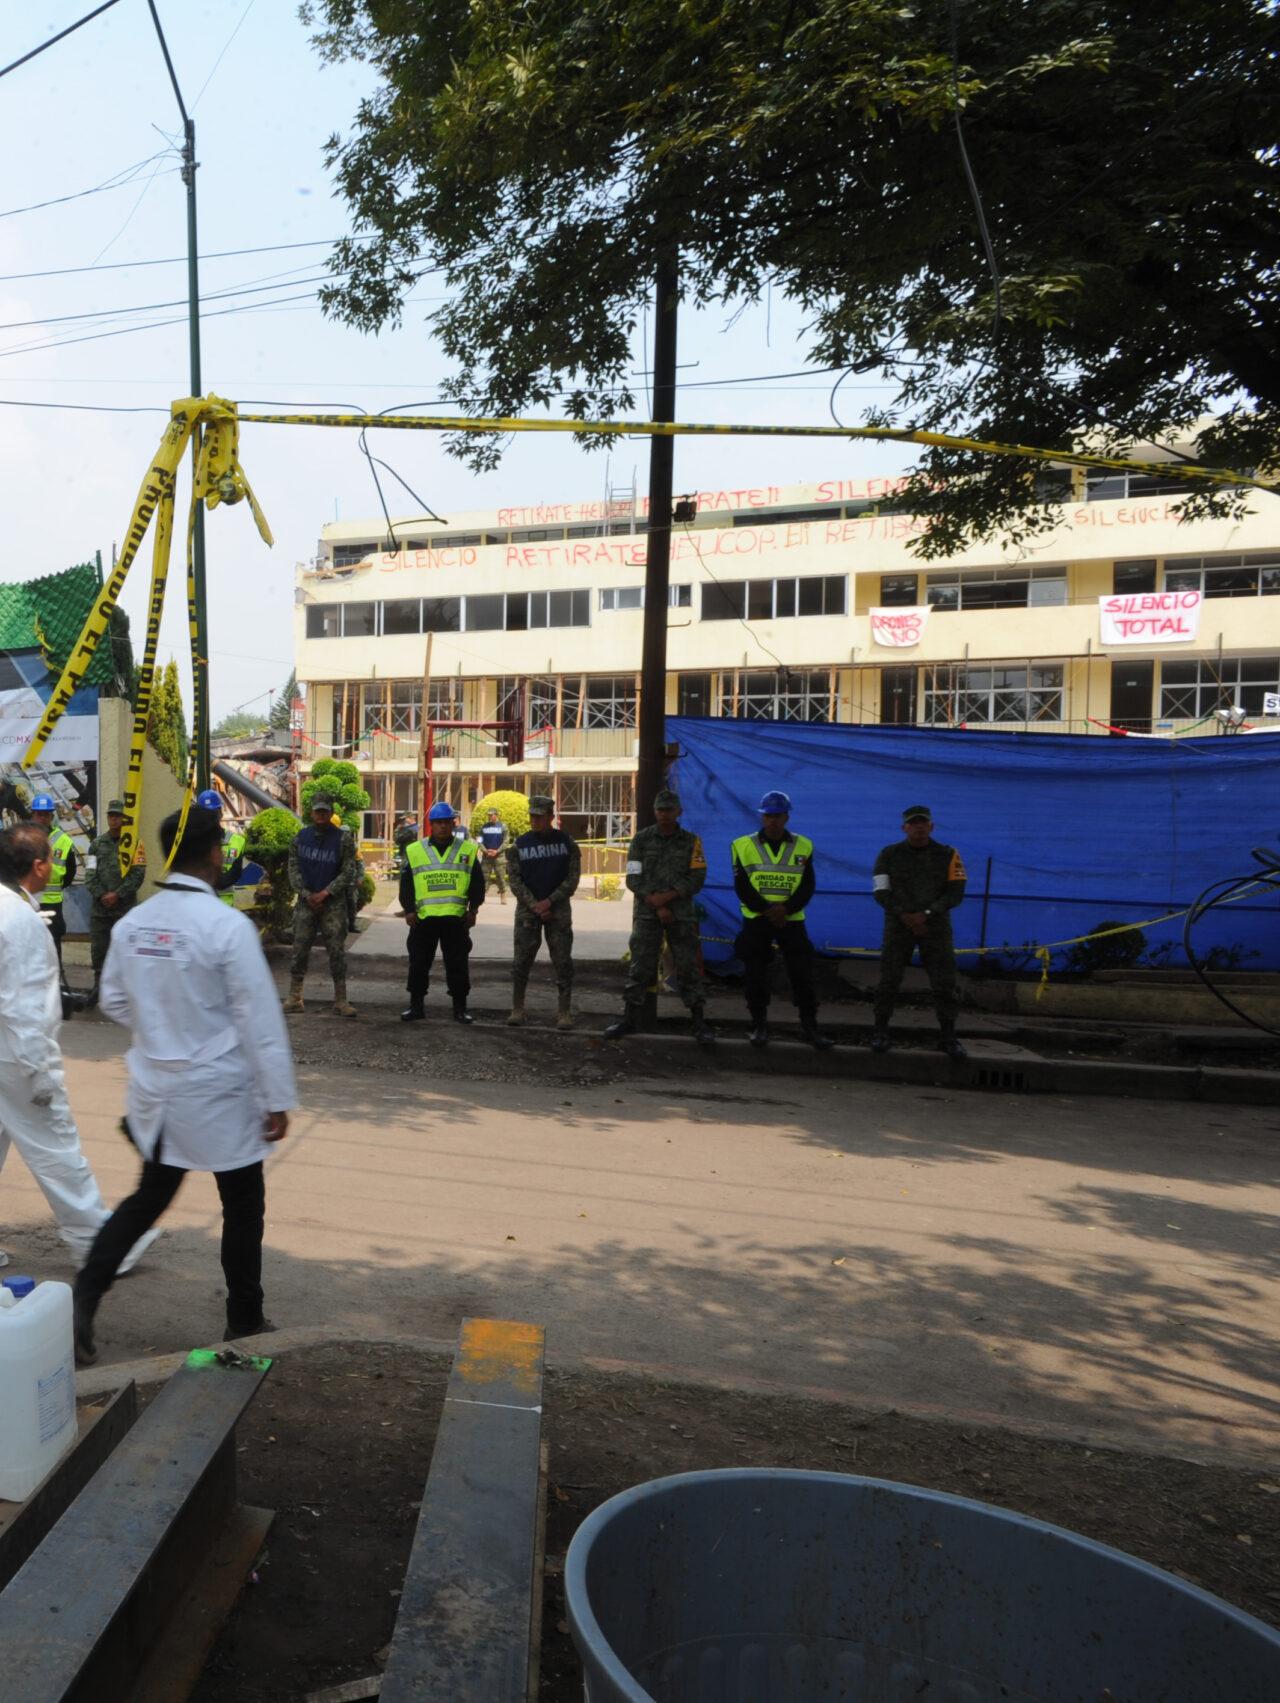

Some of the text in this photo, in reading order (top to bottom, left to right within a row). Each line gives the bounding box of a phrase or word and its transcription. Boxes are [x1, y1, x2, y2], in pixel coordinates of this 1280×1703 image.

[379, 547, 478, 572] SILENCIO
[506, 543, 647, 568] RETIRATE
[1104, 592, 1199, 614] SILENCIO
[1114, 616, 1190, 637] TOTAL
[519, 843, 568, 861] MARINA
[422, 872, 449, 880] UNIDAD
[754, 874, 785, 882] UNIDAD
